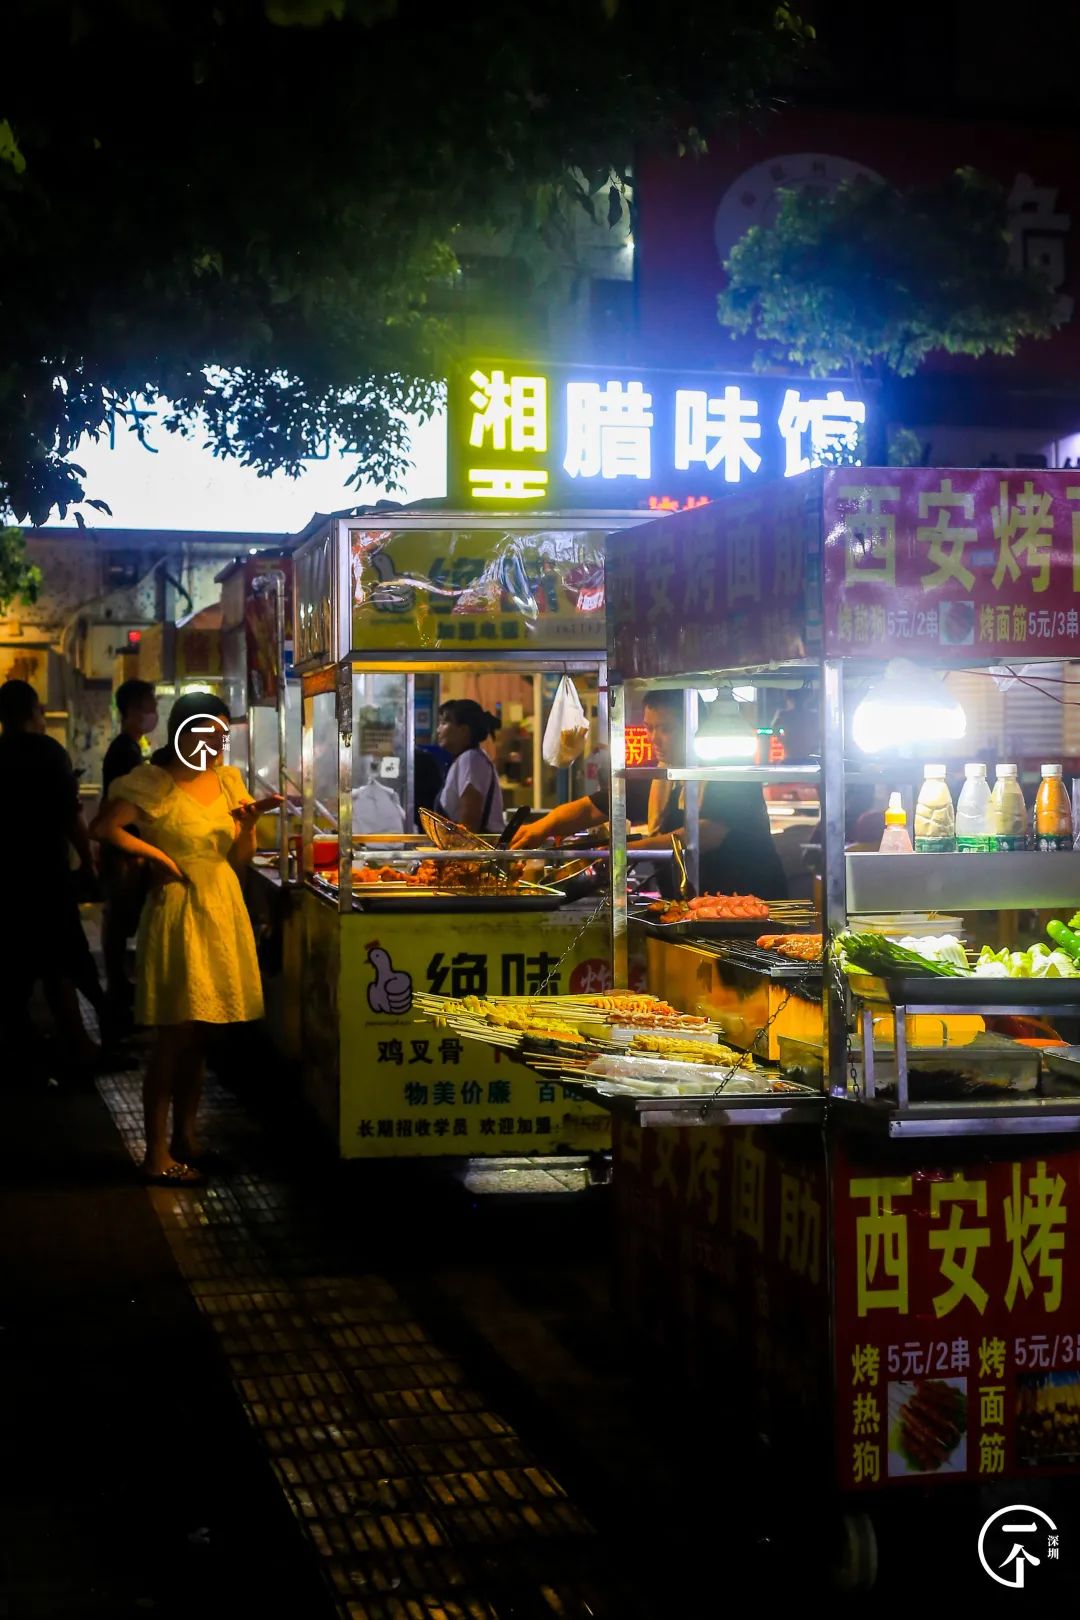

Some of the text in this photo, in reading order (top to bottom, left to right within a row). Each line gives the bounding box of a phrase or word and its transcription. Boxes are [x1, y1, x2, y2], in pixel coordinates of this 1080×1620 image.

[563, 380, 866, 484] 腊味馆
[377, 1038, 463, 1065] 鸡叉骨
[404, 1080, 512, 1106] 物美价廉
[357, 1117, 468, 1138] 长期招收学员
[849, 1160, 1068, 1319] 西安烤
[887, 1336, 970, 1376] 5元/2串
[1014, 1334, 1080, 1369] 5元/3
[851, 1343, 881, 1484] 烤热狗
[978, 1336, 1007, 1474] 烤面筋
